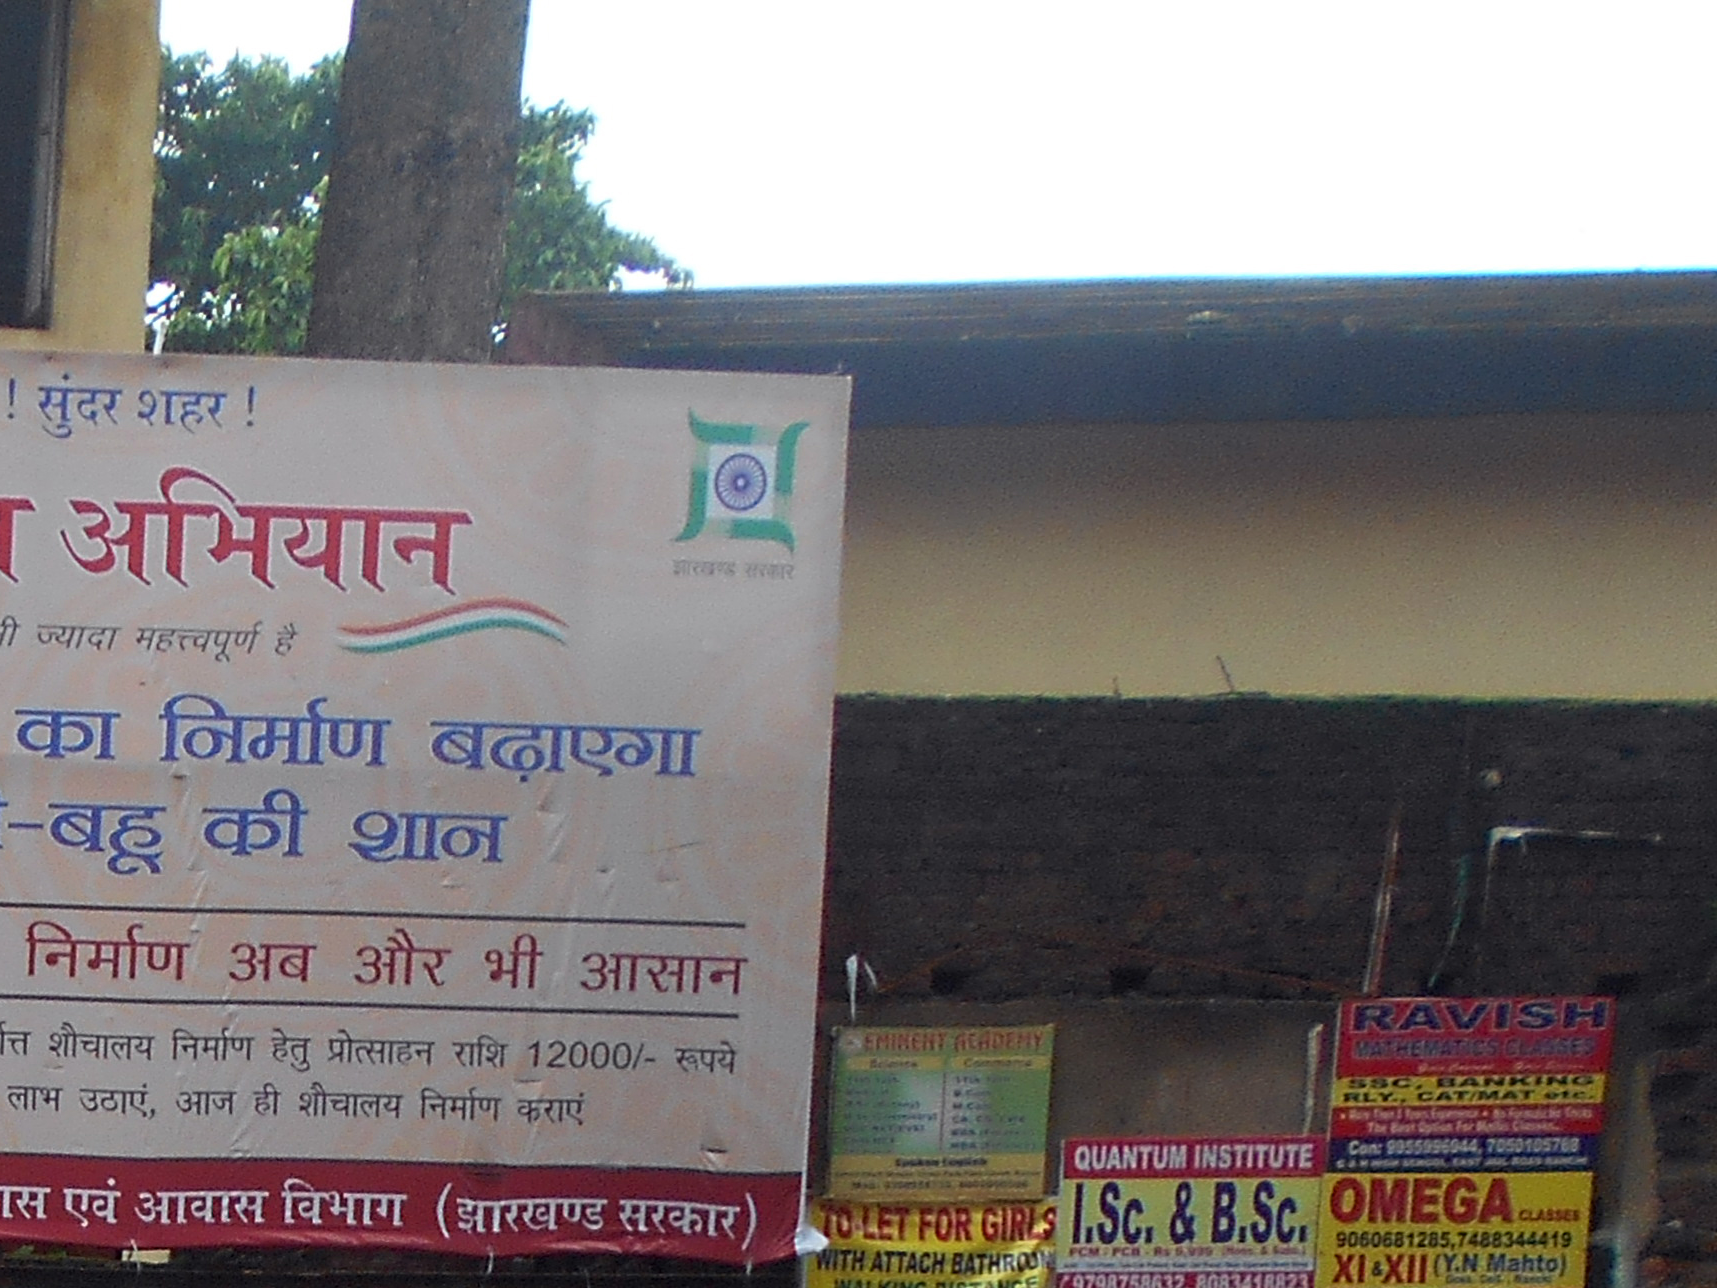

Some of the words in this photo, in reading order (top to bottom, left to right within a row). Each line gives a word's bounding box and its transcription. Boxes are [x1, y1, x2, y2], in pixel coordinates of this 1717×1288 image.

[37, 373, 123, 438] सुंदर
[136, 388, 227, 433] शहर
[59, 465, 473, 597] अभियान
[35, 624, 122, 651] ज्यादा
[274, 619, 301, 655] है
[14, 708, 121, 763] का
[158, 693, 392, 766] निर्माण
[430, 718, 703, 783] बढ़ाएगा
[202, 788, 309, 858] की
[348, 809, 509, 864] शान
[25, 920, 191, 982] निर्माण
[228, 942, 318, 984] अब
[354, 928, 453, 990] और
[484, 932, 544, 990] भी
[580, 953, 750, 997] आसान
[1350, 1000, 1609, 1033] RAVISH
[47, 1021, 156, 1060] शौचालय
[171, 1027, 255, 1062] निर्माण
[271, 1030, 311, 1072] हेतु
[326, 1028, 437, 1068] प्रोत्साहन
[453, 1035, 511, 1070] राशि
[528, 1041, 656, 1072] 12000/-
[7, 1085, 63, 1114] लाभ
[175, 1088, 236, 1116] आज
[254, 1083, 280, 1116] ही
[299, 1081, 401, 1119] शौचालय
[420, 1086, 501, 1122] निर्माण
[1348, 1078, 1424, 1091] SSC,
[1435, 1075, 1596, 1089] BANKING
[1417, 1090, 1532, 1103] CAT/MAT
[1074, 1144, 1187, 1172] QUANTUM
[1194, 1143, 1314, 1170] INSTITUTE
[64, 1178, 120, 1228] एवं
[136, 1190, 265, 1227] आवास
[281, 1178, 408, 1229] विभाग
[1072, 1180, 1154, 1245] I.Sc.
[1169, 1180, 1196, 1245] &
[1211, 1179, 1308, 1244] B.Sc.
[1329, 1176, 1515, 1224] OMEGA
[1518, 1208, 1580, 1222] CLASSES
[918, 1205, 973, 1243] FOR
[980, 1204, 1058, 1243] GIRLS
[816, 1250, 864, 1272] WITH
[870, 1251, 945, 1275] ATTACH
[1332, 1253, 1366, 1284] XI
[1381, 1253, 1429, 1284] XII
